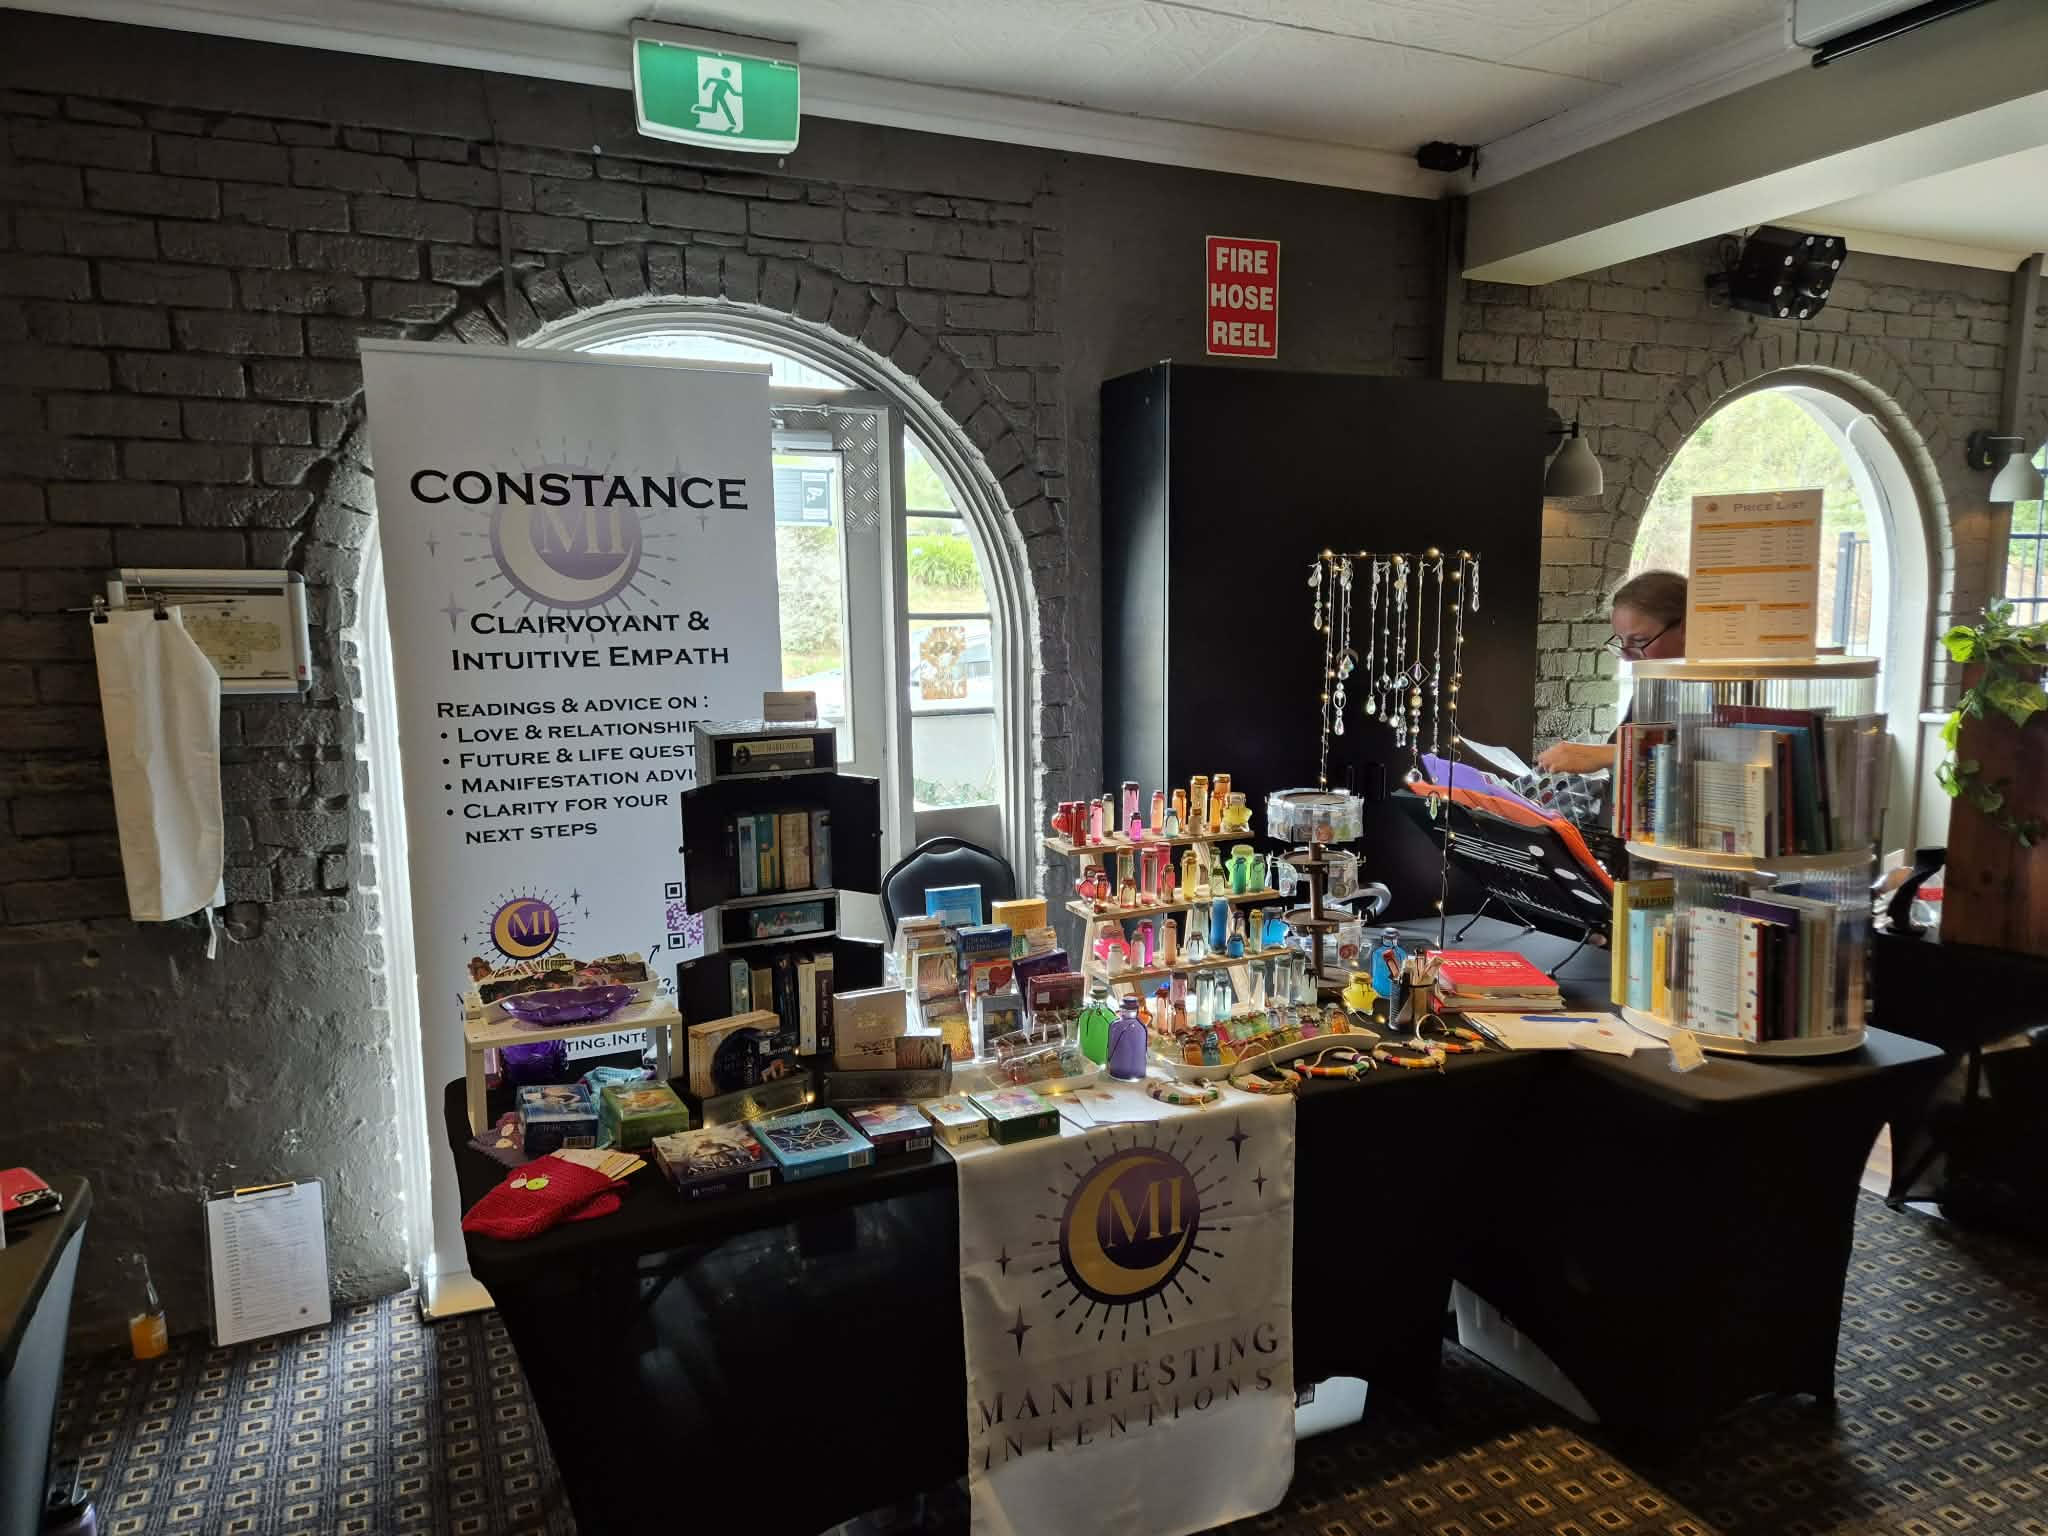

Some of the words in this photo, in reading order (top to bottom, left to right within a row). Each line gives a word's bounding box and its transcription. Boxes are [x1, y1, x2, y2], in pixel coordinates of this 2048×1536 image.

[1216, 247, 1269, 274] FIRE
[1211, 283, 1274, 311] HOSE
[1213, 321, 1271, 348] REEL
[410, 469, 748, 510] CONSTANCE
[687, 611, 710, 631] &
[452, 648, 600, 671] INTUITIVE
[609, 646, 729, 668] EMPATH
[561, 698, 578, 713] &
[584, 697, 662, 713] ADVICE
[525, 725, 542, 740] &
[548, 720, 712, 739] RELATIONSHIP
[556, 748, 573, 763] &
[579, 747, 623, 763] LIFE
[629, 744, 696, 761] QUEST
[646, 768, 697, 783] ADVI
[565, 797, 608, 812] FOR
[613, 794, 668, 809] YOUR
[465, 827, 524, 845] NEXT
[531, 822, 598, 839] STEPS
[567, 1031, 648, 1052] TING.INTE
[978, 1321, 1278, 1434] MANIFESTING
[984, 1367, 1273, 1470] INTENTIONS
